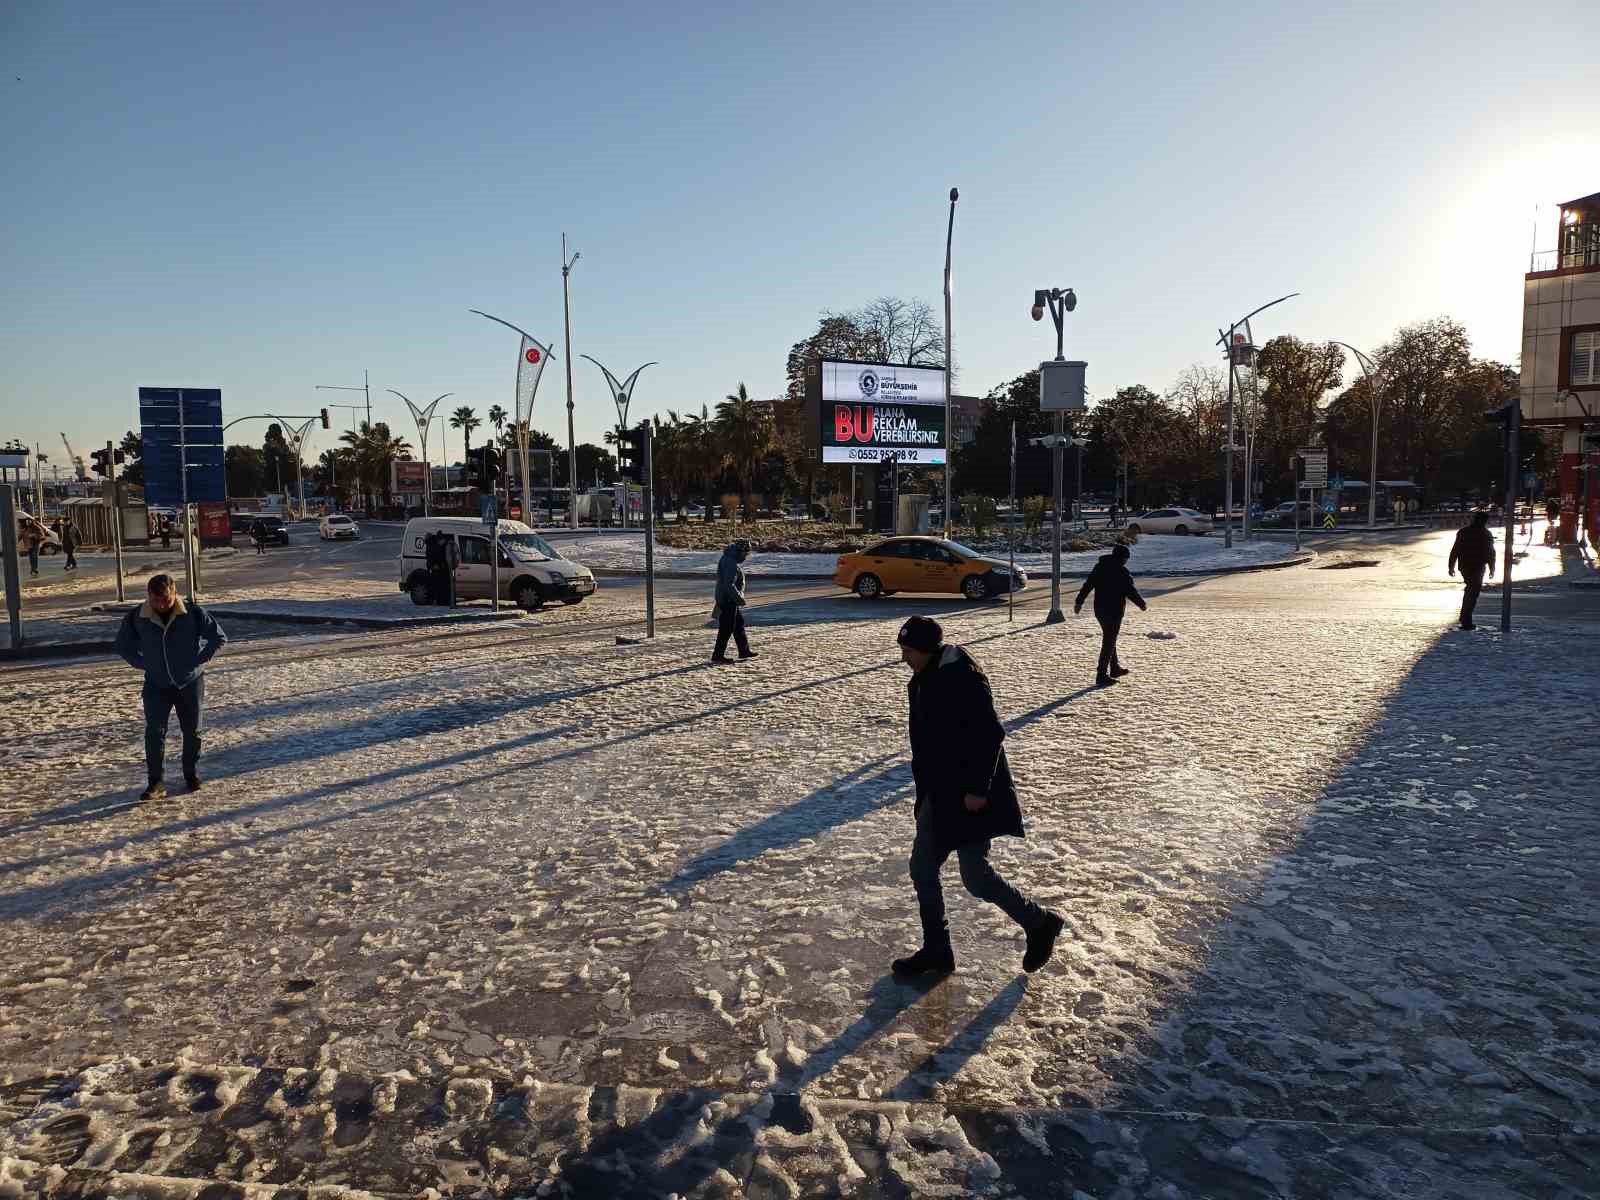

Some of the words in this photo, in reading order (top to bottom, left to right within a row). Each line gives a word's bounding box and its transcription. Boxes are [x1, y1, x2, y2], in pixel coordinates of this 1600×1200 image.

[874, 407, 905, 418] ALANA
[835, 404, 873, 442] BU
[874, 418, 917, 430] REKLAM
[858, 449, 877, 459] 0552
[909, 450, 918, 460] 92
